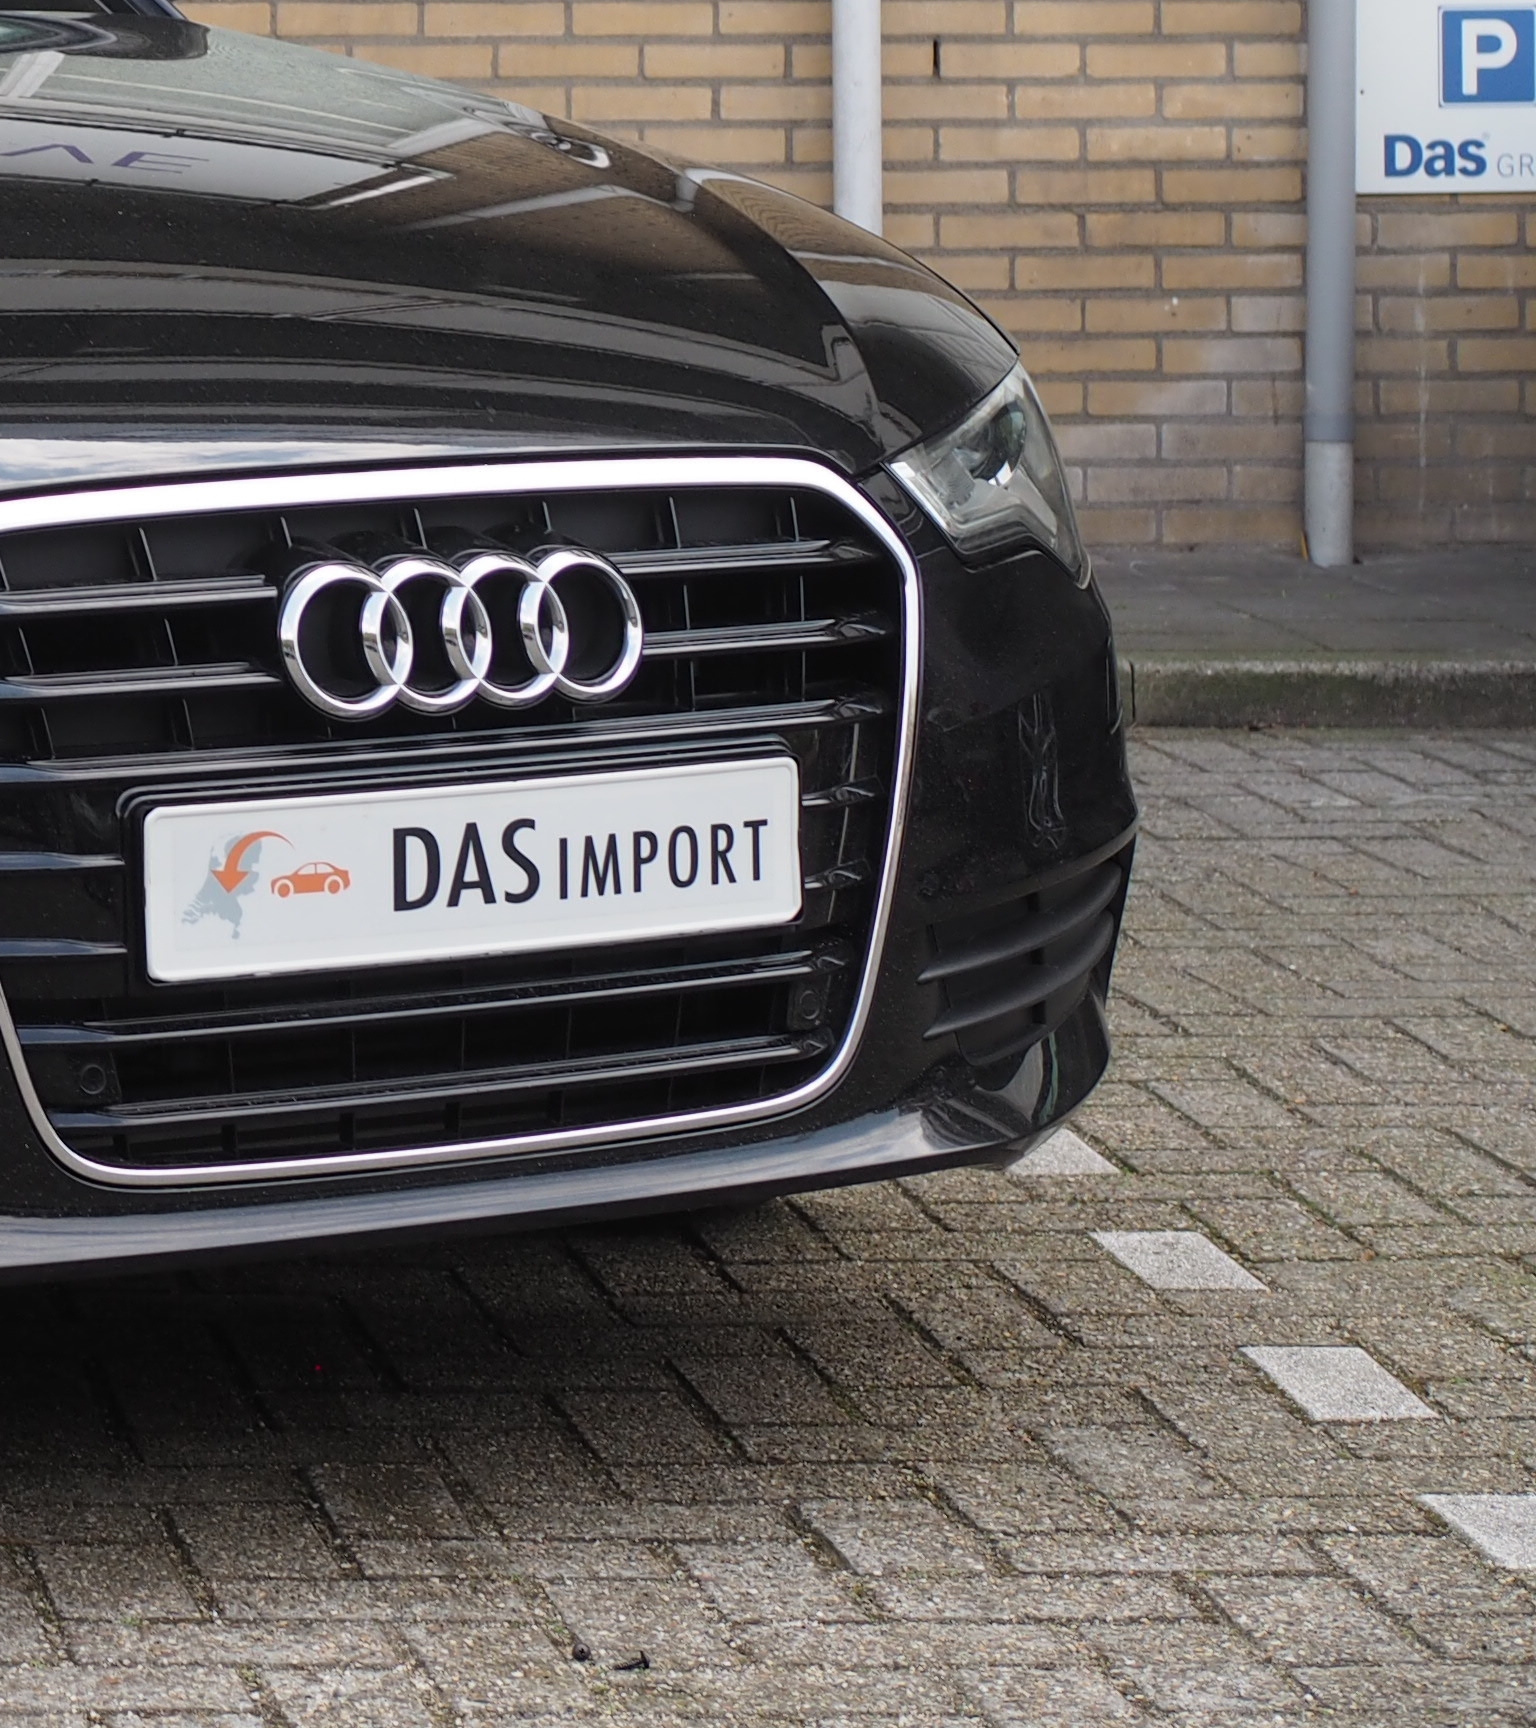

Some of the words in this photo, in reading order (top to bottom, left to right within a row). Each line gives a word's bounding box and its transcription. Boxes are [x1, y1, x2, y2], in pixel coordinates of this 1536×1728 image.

[1461, 19, 1517, 96] P
[392, 819, 541, 912] DAS
[559, 819, 769, 901] IMPORT
